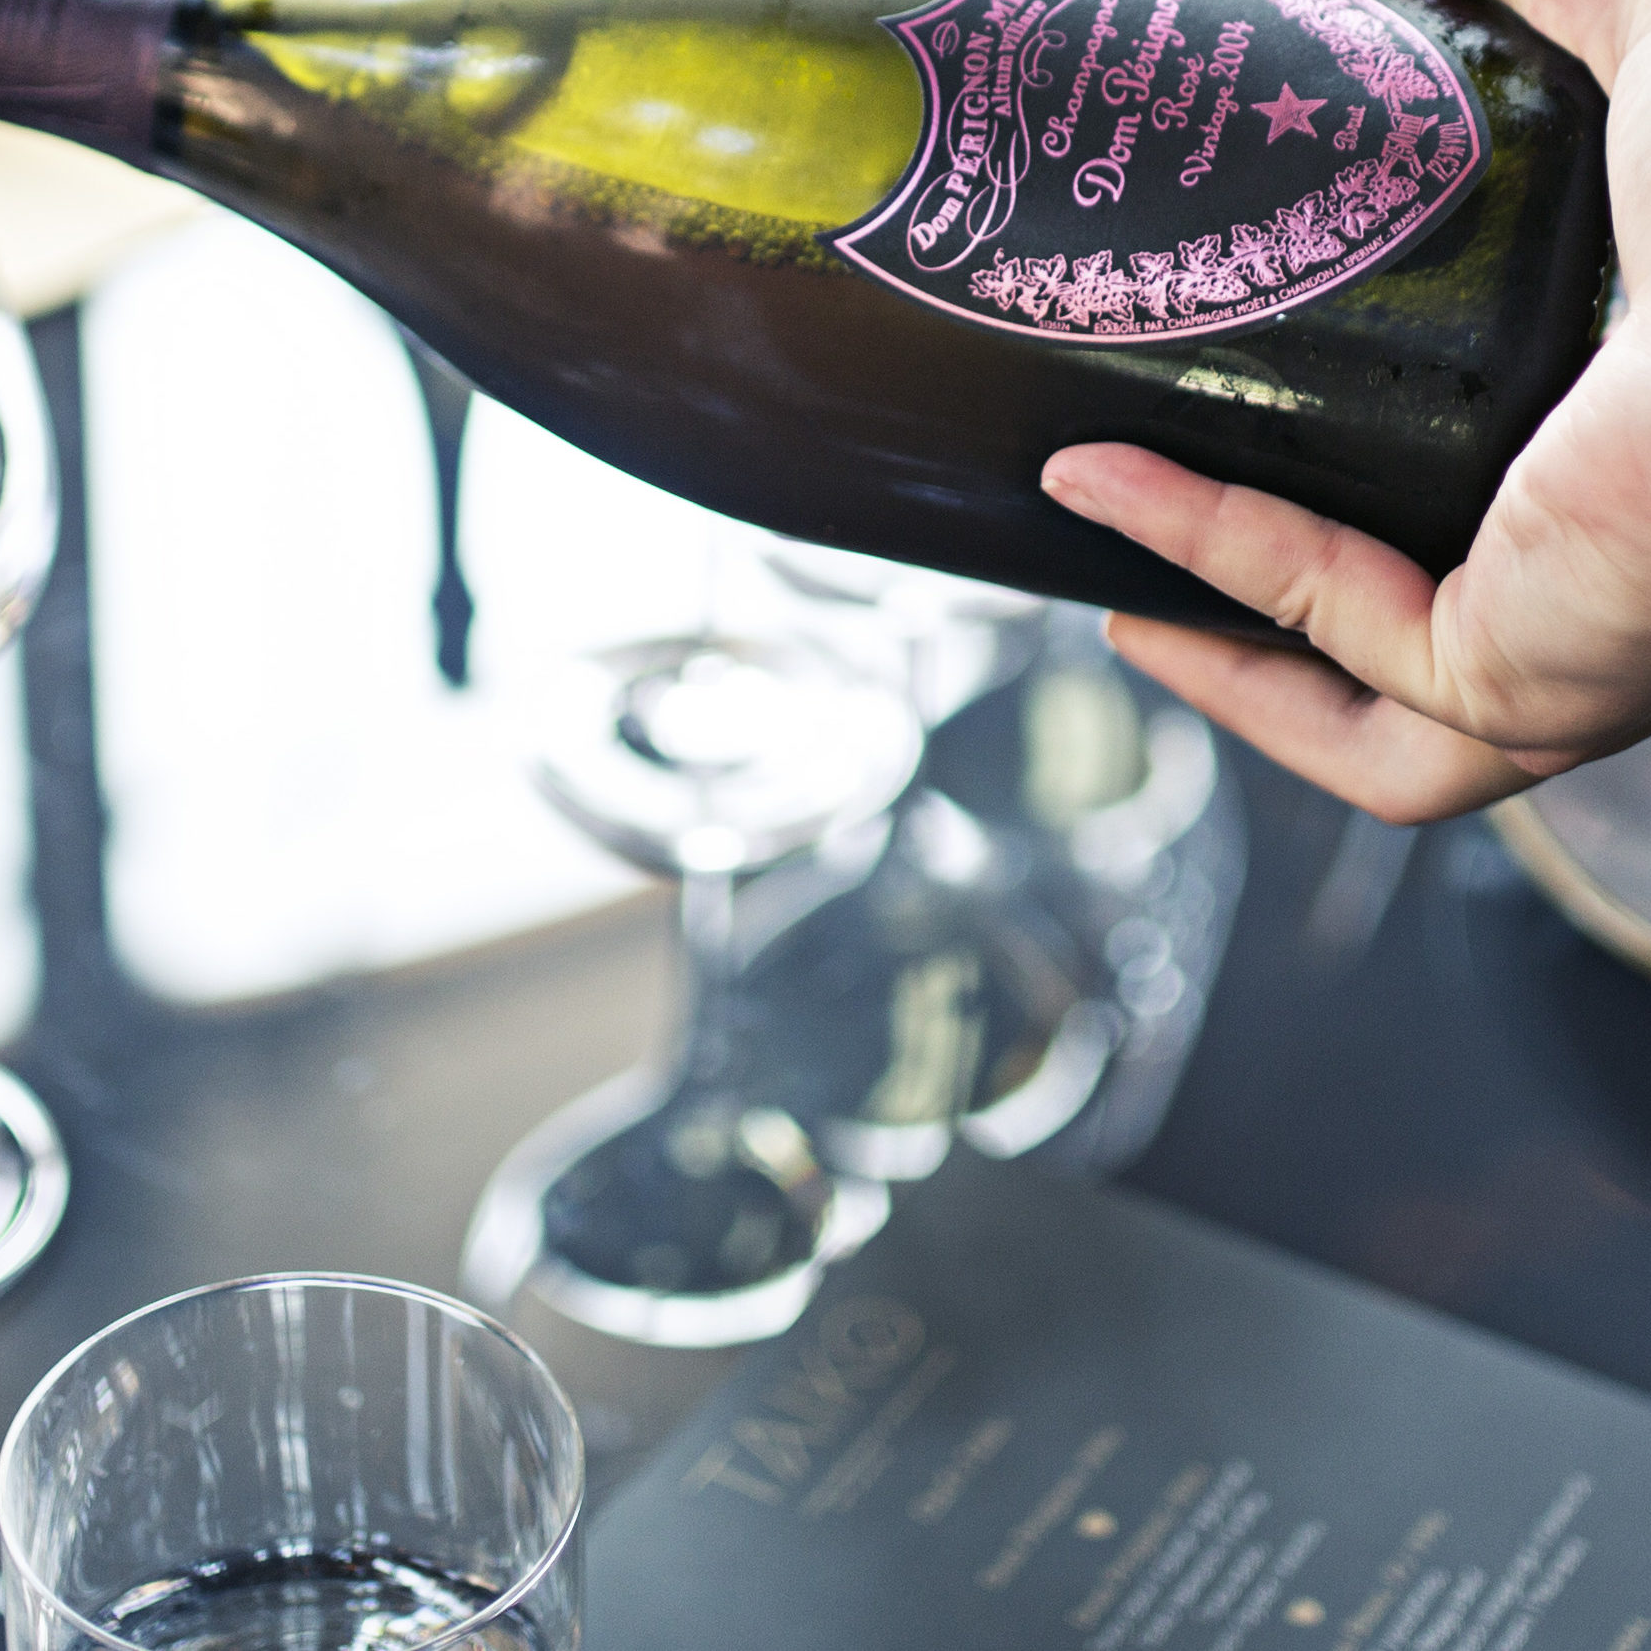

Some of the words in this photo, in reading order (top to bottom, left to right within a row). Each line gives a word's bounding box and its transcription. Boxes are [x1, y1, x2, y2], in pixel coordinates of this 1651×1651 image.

[990, 54, 1014, 117] Altum
[1151, 52, 1205, 131] Rosé
[1207, 19, 1255, 81] 2004
[911, 196, 964, 251] Dom
[945, 30, 994, 198] PERIGNON
[1072, 111, 1142, 208] Dom
[1179, 83, 1240, 187] Vintage
[1333, 104, 1367, 150] Brut
[1144, 319, 1165, 332] PAR
[1166, 305, 1235, 330] CHAMPAGNE
[1278, 266, 1335, 300] CHANDON
[1343, 234, 1386, 269] EPERNAY
[1389, 201, 1427, 235] FRANCE
